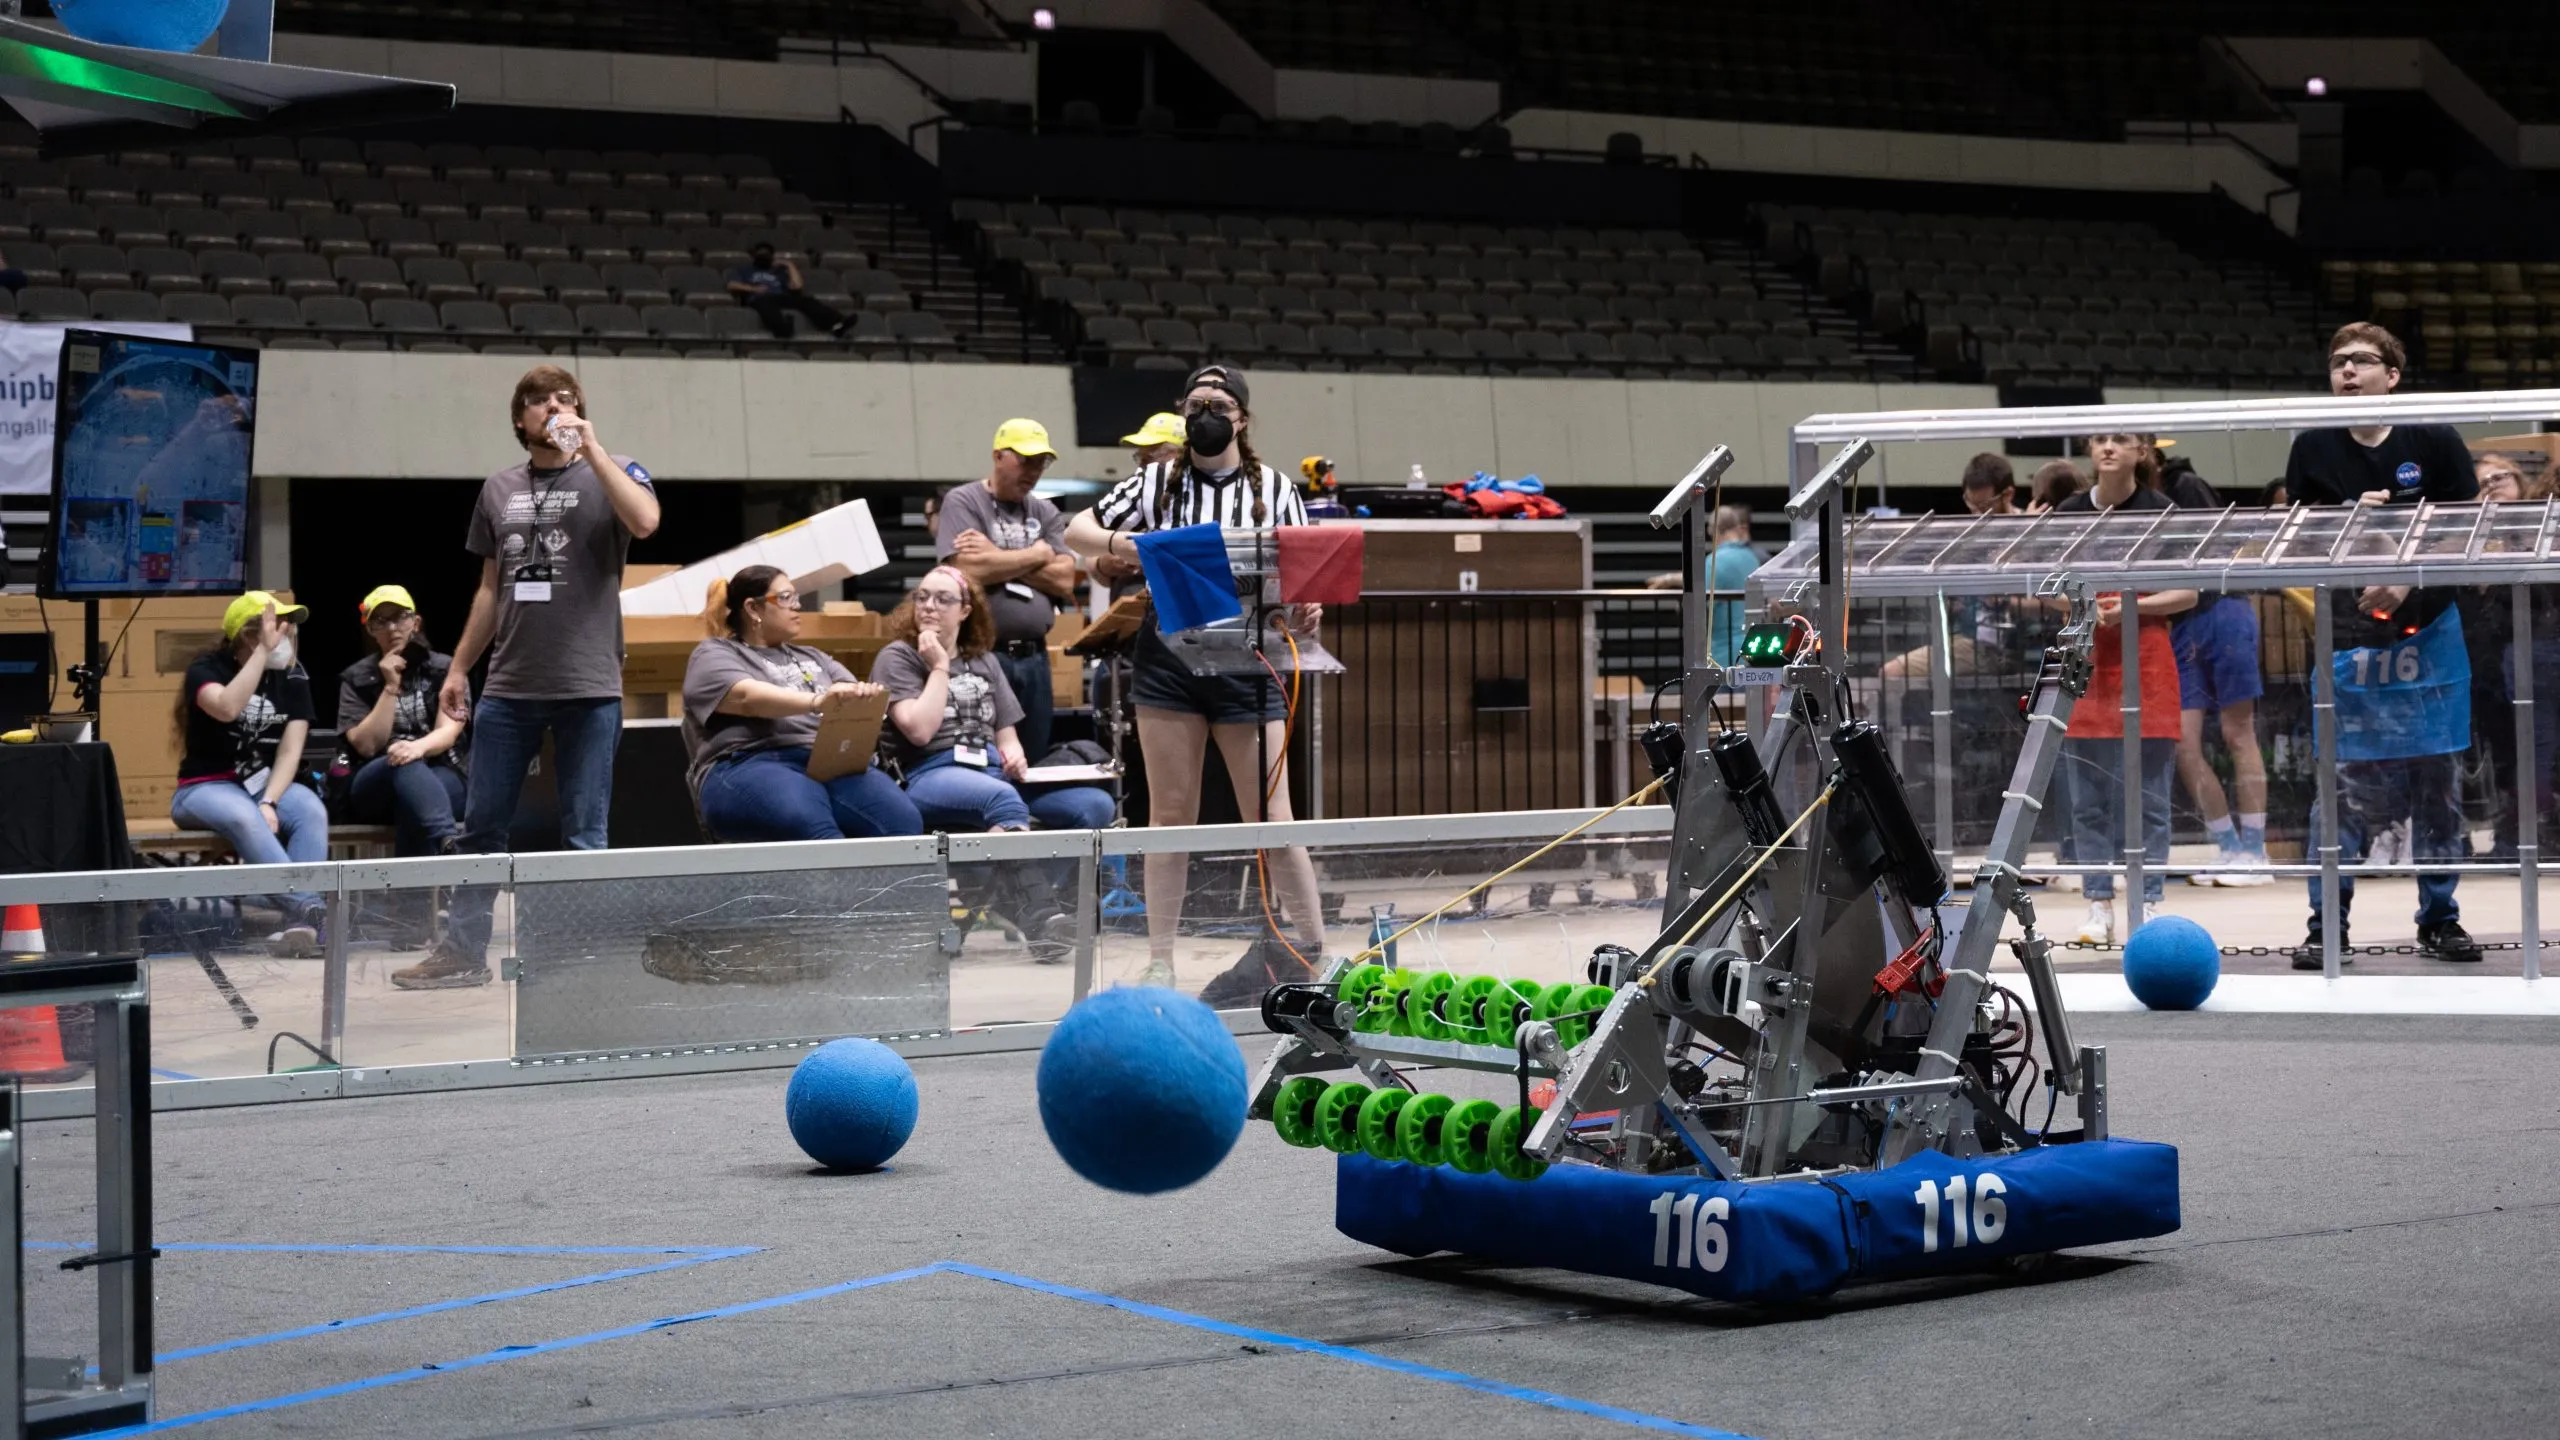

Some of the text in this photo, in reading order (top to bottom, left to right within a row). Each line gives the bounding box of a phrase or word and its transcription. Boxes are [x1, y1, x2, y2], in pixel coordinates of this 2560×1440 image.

[2398, 470, 2420, 480] NASA
[2352, 645, 2420, 685] 116
[1649, 1190, 1729, 1273] 116
[1915, 1172, 2007, 1253] 116
